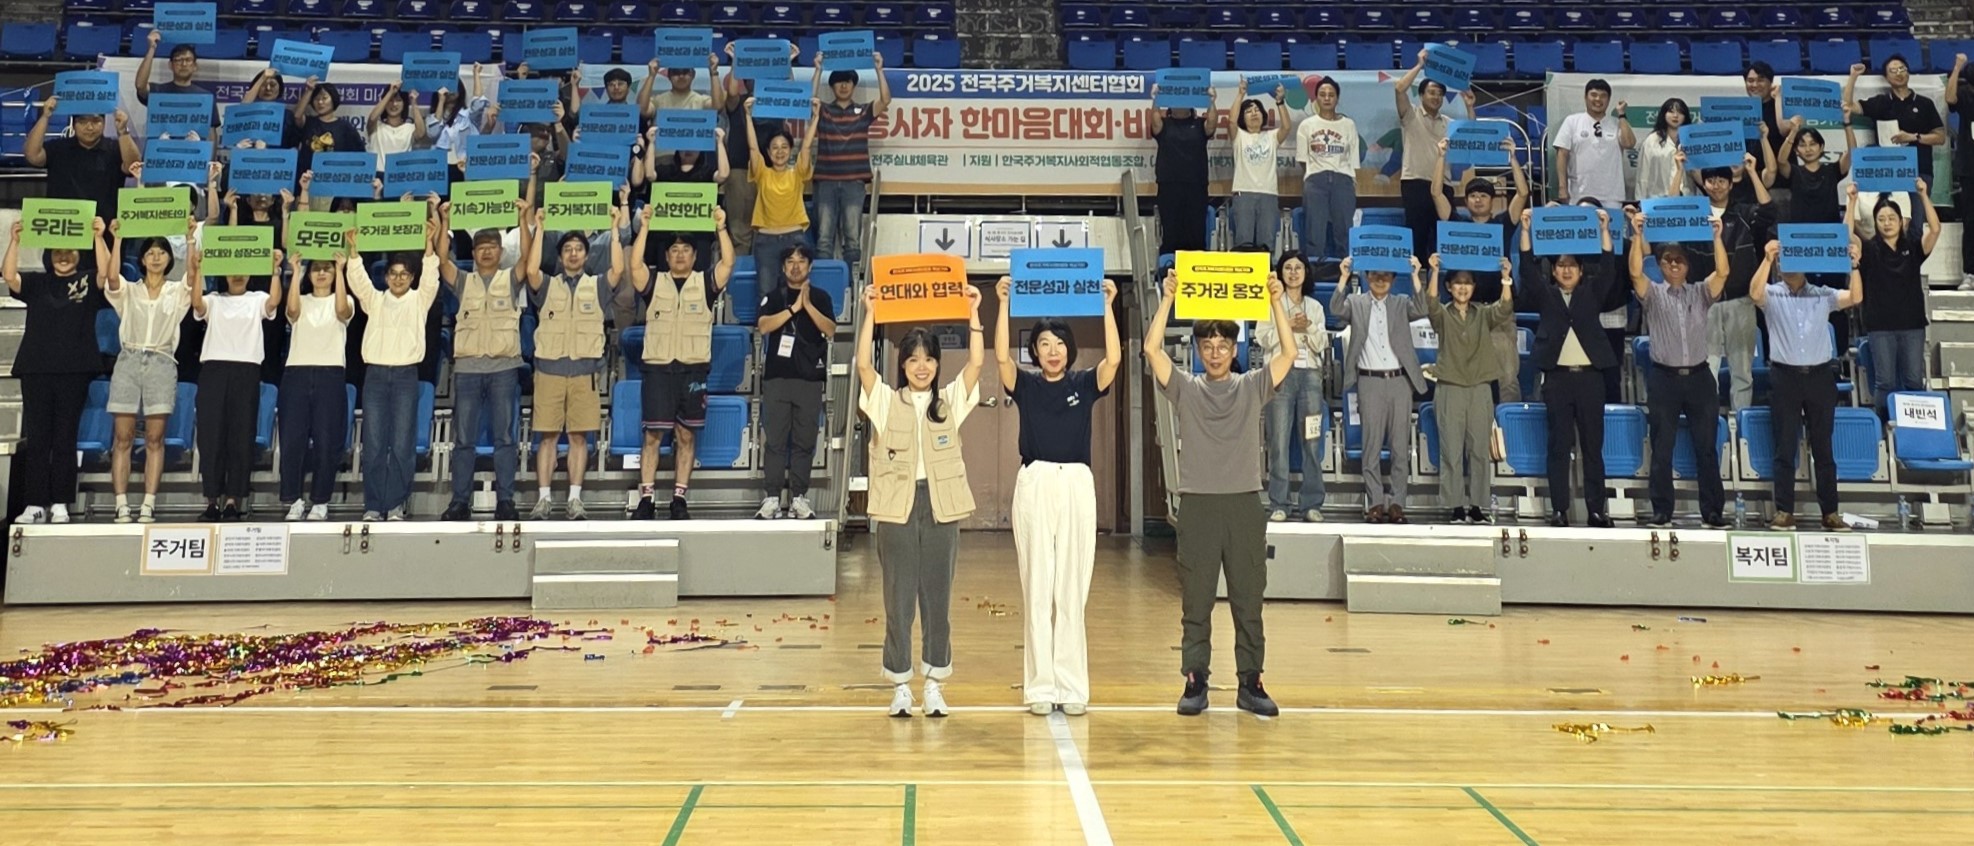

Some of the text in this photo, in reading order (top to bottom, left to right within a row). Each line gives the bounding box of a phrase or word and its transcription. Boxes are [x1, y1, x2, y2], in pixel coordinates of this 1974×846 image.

[157, 21, 213, 31] 전문성과 실천
[524, 46, 575, 57] 전문성과 실천
[658, 46, 709, 56] 전문성과 실천
[823, 48, 873, 59] 전문성과 실천
[273, 55, 327, 69] 전문성과 실천
[737, 57, 788, 67] 전문성과 실천
[405, 69, 456, 80] 전문성과 실천
[907, 74, 1145, 93] 2025 전국주거복지센터협회
[56, 90, 116, 101] 전문성과 실천
[501, 100, 536, 109] 전문성과
[756, 97, 809, 108] 전문성과 실천
[1785, 97, 1841, 109] 전문성과 실천
[150, 113, 209, 124] 전문성과 실천
[226, 121, 280, 133] 전문성과 실천
[581, 123, 636, 134] 전문성과 실천
[659, 127, 713, 138] 전문성과 실천
[1450, 139, 1485, 150] 전문성과
[1724, 142, 1743, 151] 실천
[469, 153, 528, 165] 전문성과 실천
[872, 155, 948, 167] 전주실내체육관
[970, 155, 991, 166] 지원
[145, 159, 207, 171] 전문성과 실천
[569, 164, 625, 175] 전문성과 실천
[232, 170, 293, 181] 전문성과 실천
[313, 172, 373, 183] 전문성과 실천
[388, 171, 445, 182] 전문성과 실천
[1855, 168, 1916, 178] 전문성과 실천
[453, 201, 515, 216] 지속가능한
[548, 203, 608, 216] 주거복지를
[654, 203, 714, 219] 실현한다
[120, 209, 187, 221] 주거복지센터의
[1646, 215, 1709, 227] 전문성과 실천
[31, 219, 85, 236] 우리는
[360, 224, 423, 237] 주거권 보장과
[295, 230, 346, 248] 모두의
[1535, 228, 1597, 239] 전문성과 실천
[203, 247, 271, 258] 연대와 성장으로
[1352, 246, 1411, 258] 전문성과 실천
[1440, 244, 1501, 256] 전문성과 실천
[1783, 246, 1847, 257] 전문성과 실천
[880, 281, 963, 300] 연대와 협력
[1015, 280, 1100, 295] 전문성과 실천
[1181, 282, 1264, 299] 주거권 옹호
[1905, 408, 1937, 420] 내빈석
[151, 538, 205, 559] 주거팀
[1735, 547, 1789, 567] 복지팀
